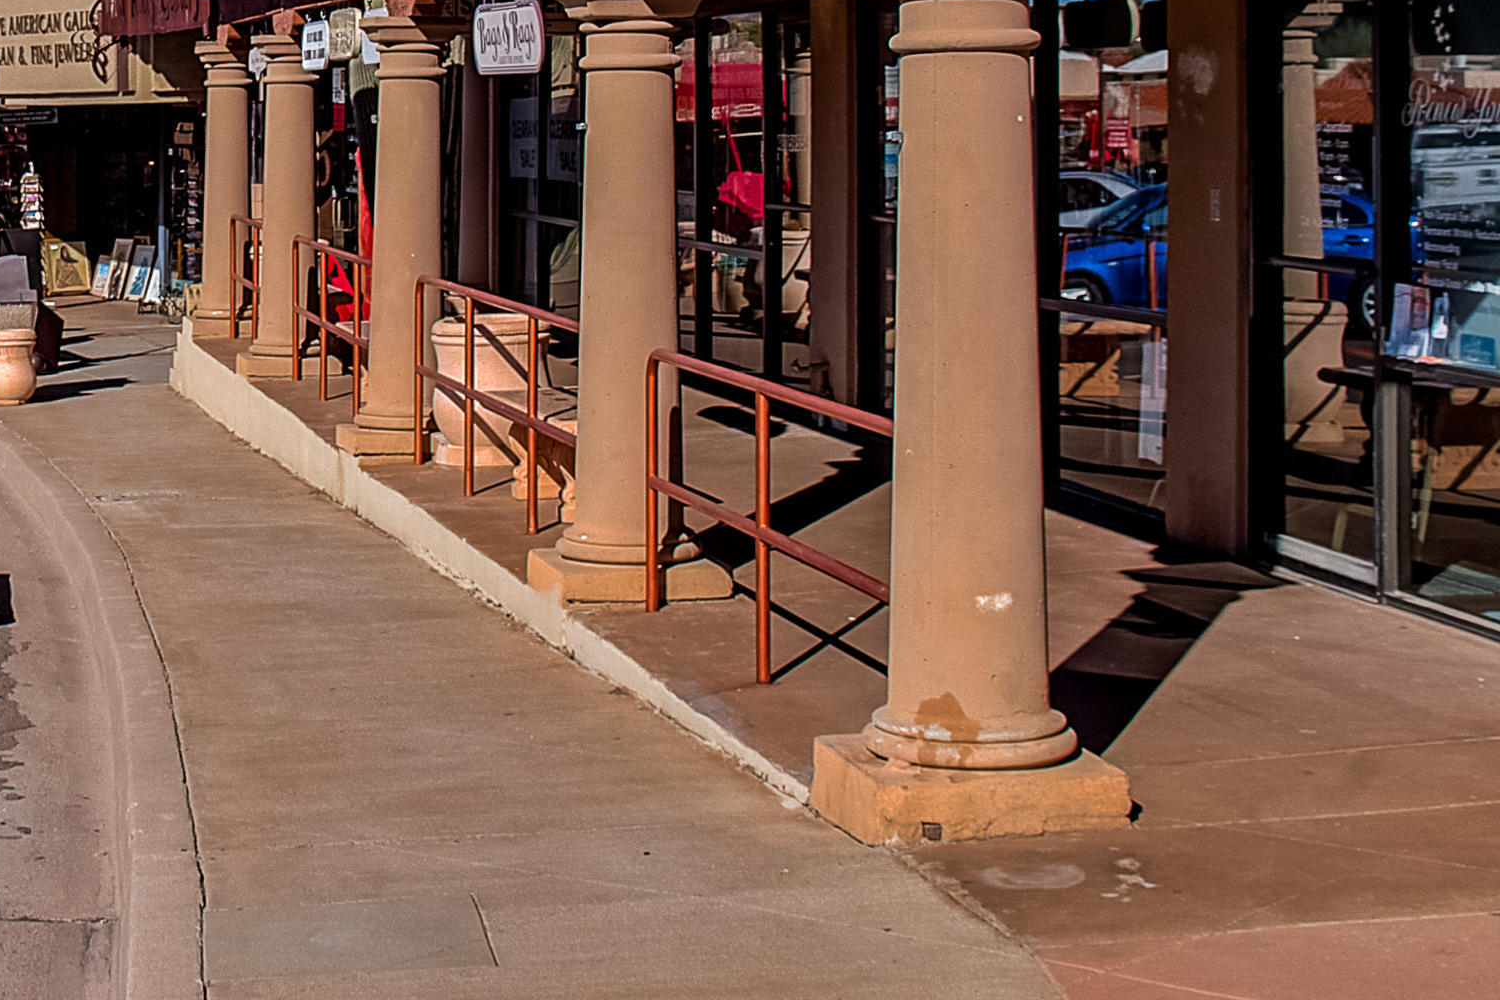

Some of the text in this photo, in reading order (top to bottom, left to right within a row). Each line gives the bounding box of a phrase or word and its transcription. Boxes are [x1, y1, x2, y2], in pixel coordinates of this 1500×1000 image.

[9, 13, 62, 35] AMERICAN
[64, 11, 97, 32] GALL
[477, 17, 501, 61] Bags
[509, 11, 536, 60] Rags
[18, 46, 28, 66] &
[30, 44, 54, 64] FINE
[54, 42, 98, 68] JEWELR
